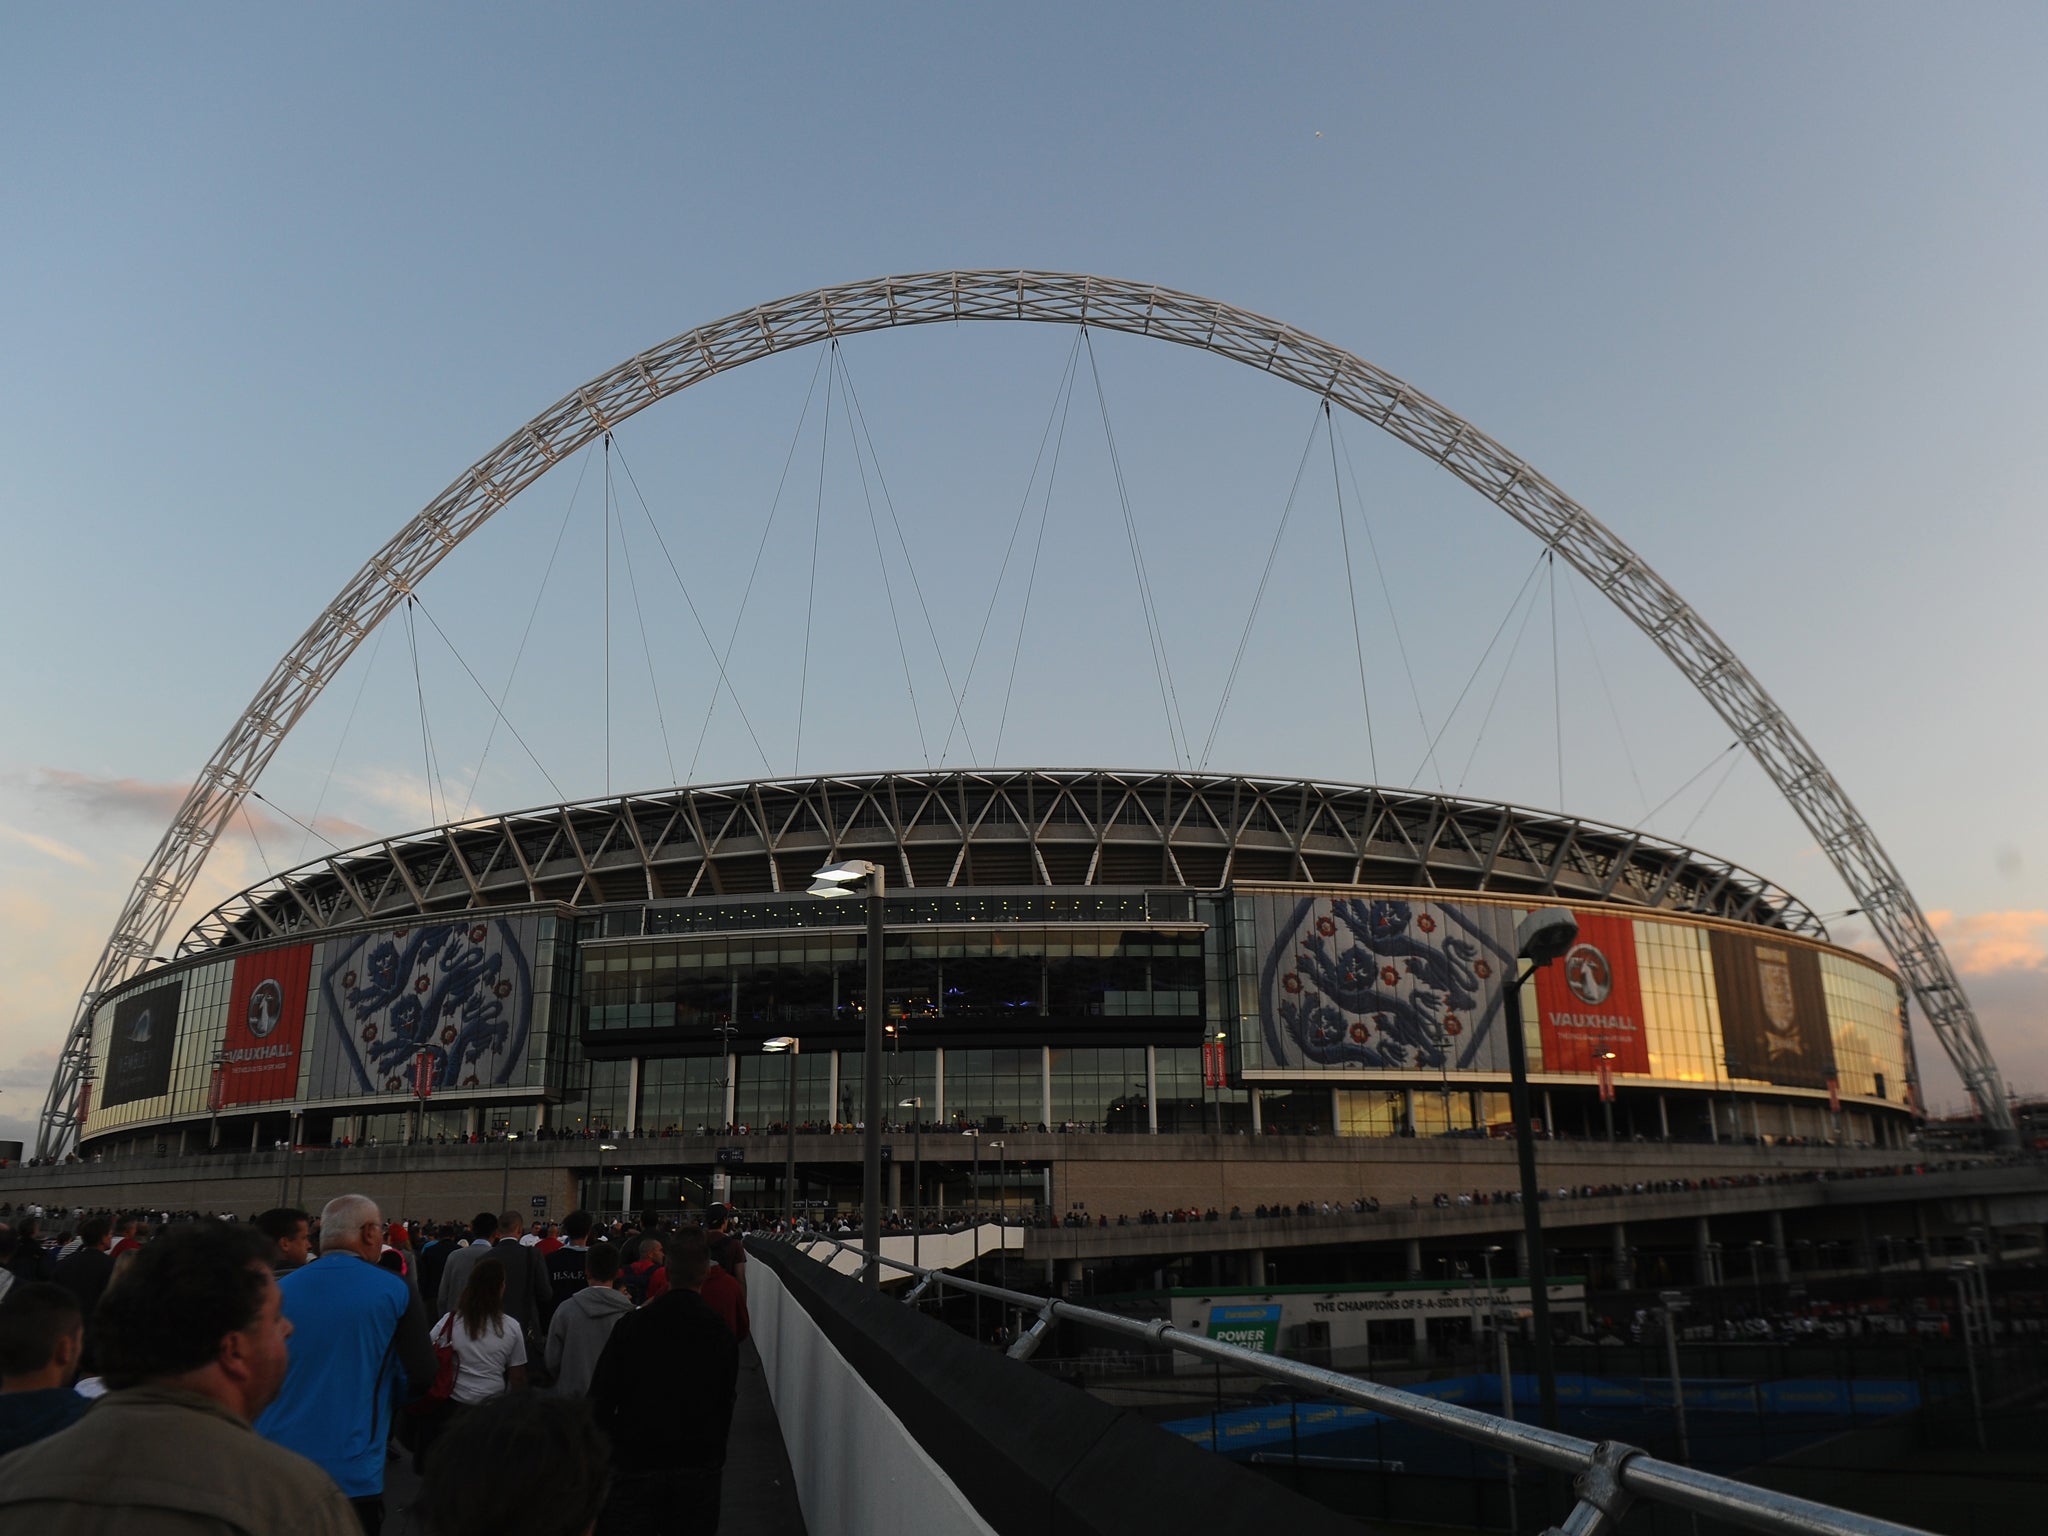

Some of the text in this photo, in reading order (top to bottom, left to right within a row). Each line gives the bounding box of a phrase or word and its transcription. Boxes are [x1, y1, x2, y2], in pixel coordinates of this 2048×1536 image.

[1548, 1012, 1637, 1031] VAUXHALL
[229, 1043, 292, 1061] VAUXHALL
[1313, 1302, 1334, 1312] THE
[1337, 1300, 1399, 1312] CHAMPIONS
[1401, 1299, 1415, 1310] OF
[1216, 1329, 1265, 1342] POWER
